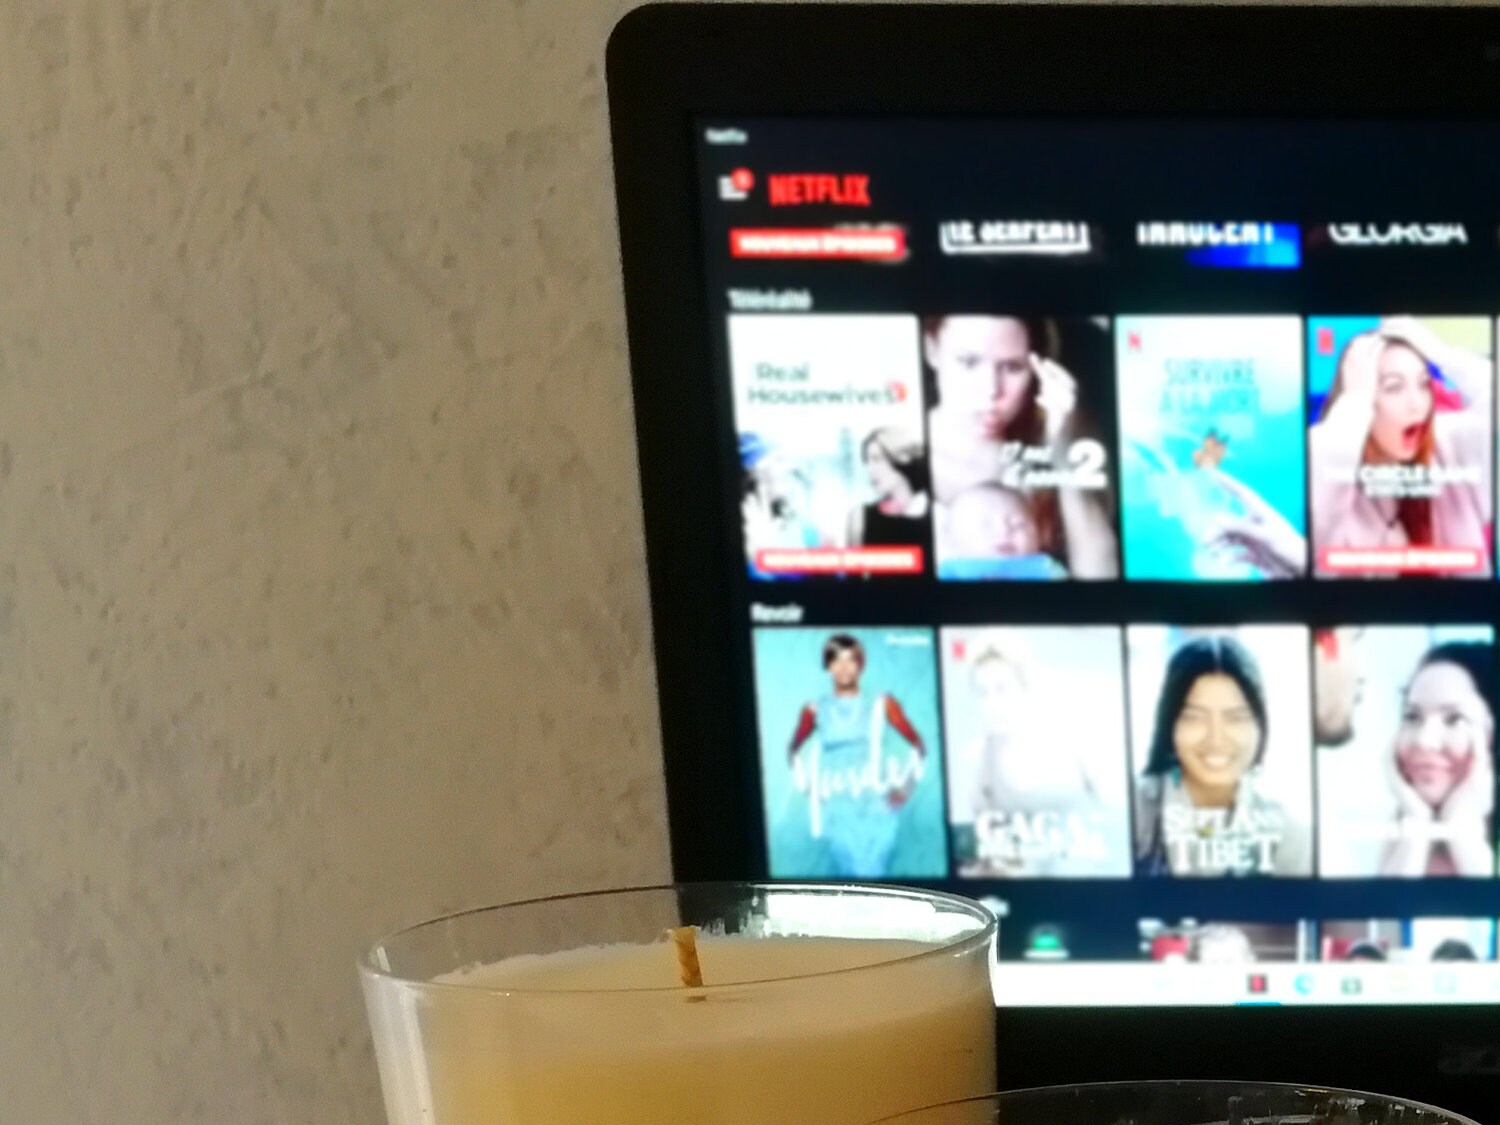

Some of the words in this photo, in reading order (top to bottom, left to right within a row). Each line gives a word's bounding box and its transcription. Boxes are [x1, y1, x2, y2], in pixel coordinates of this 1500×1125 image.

[768, 173, 871, 207] NETFLIX
[756, 361, 810, 383] Real
[747, 383, 899, 405] Housewives
[1067, 438, 1108, 488] 2
[1167, 834, 1282, 873] TIBET
